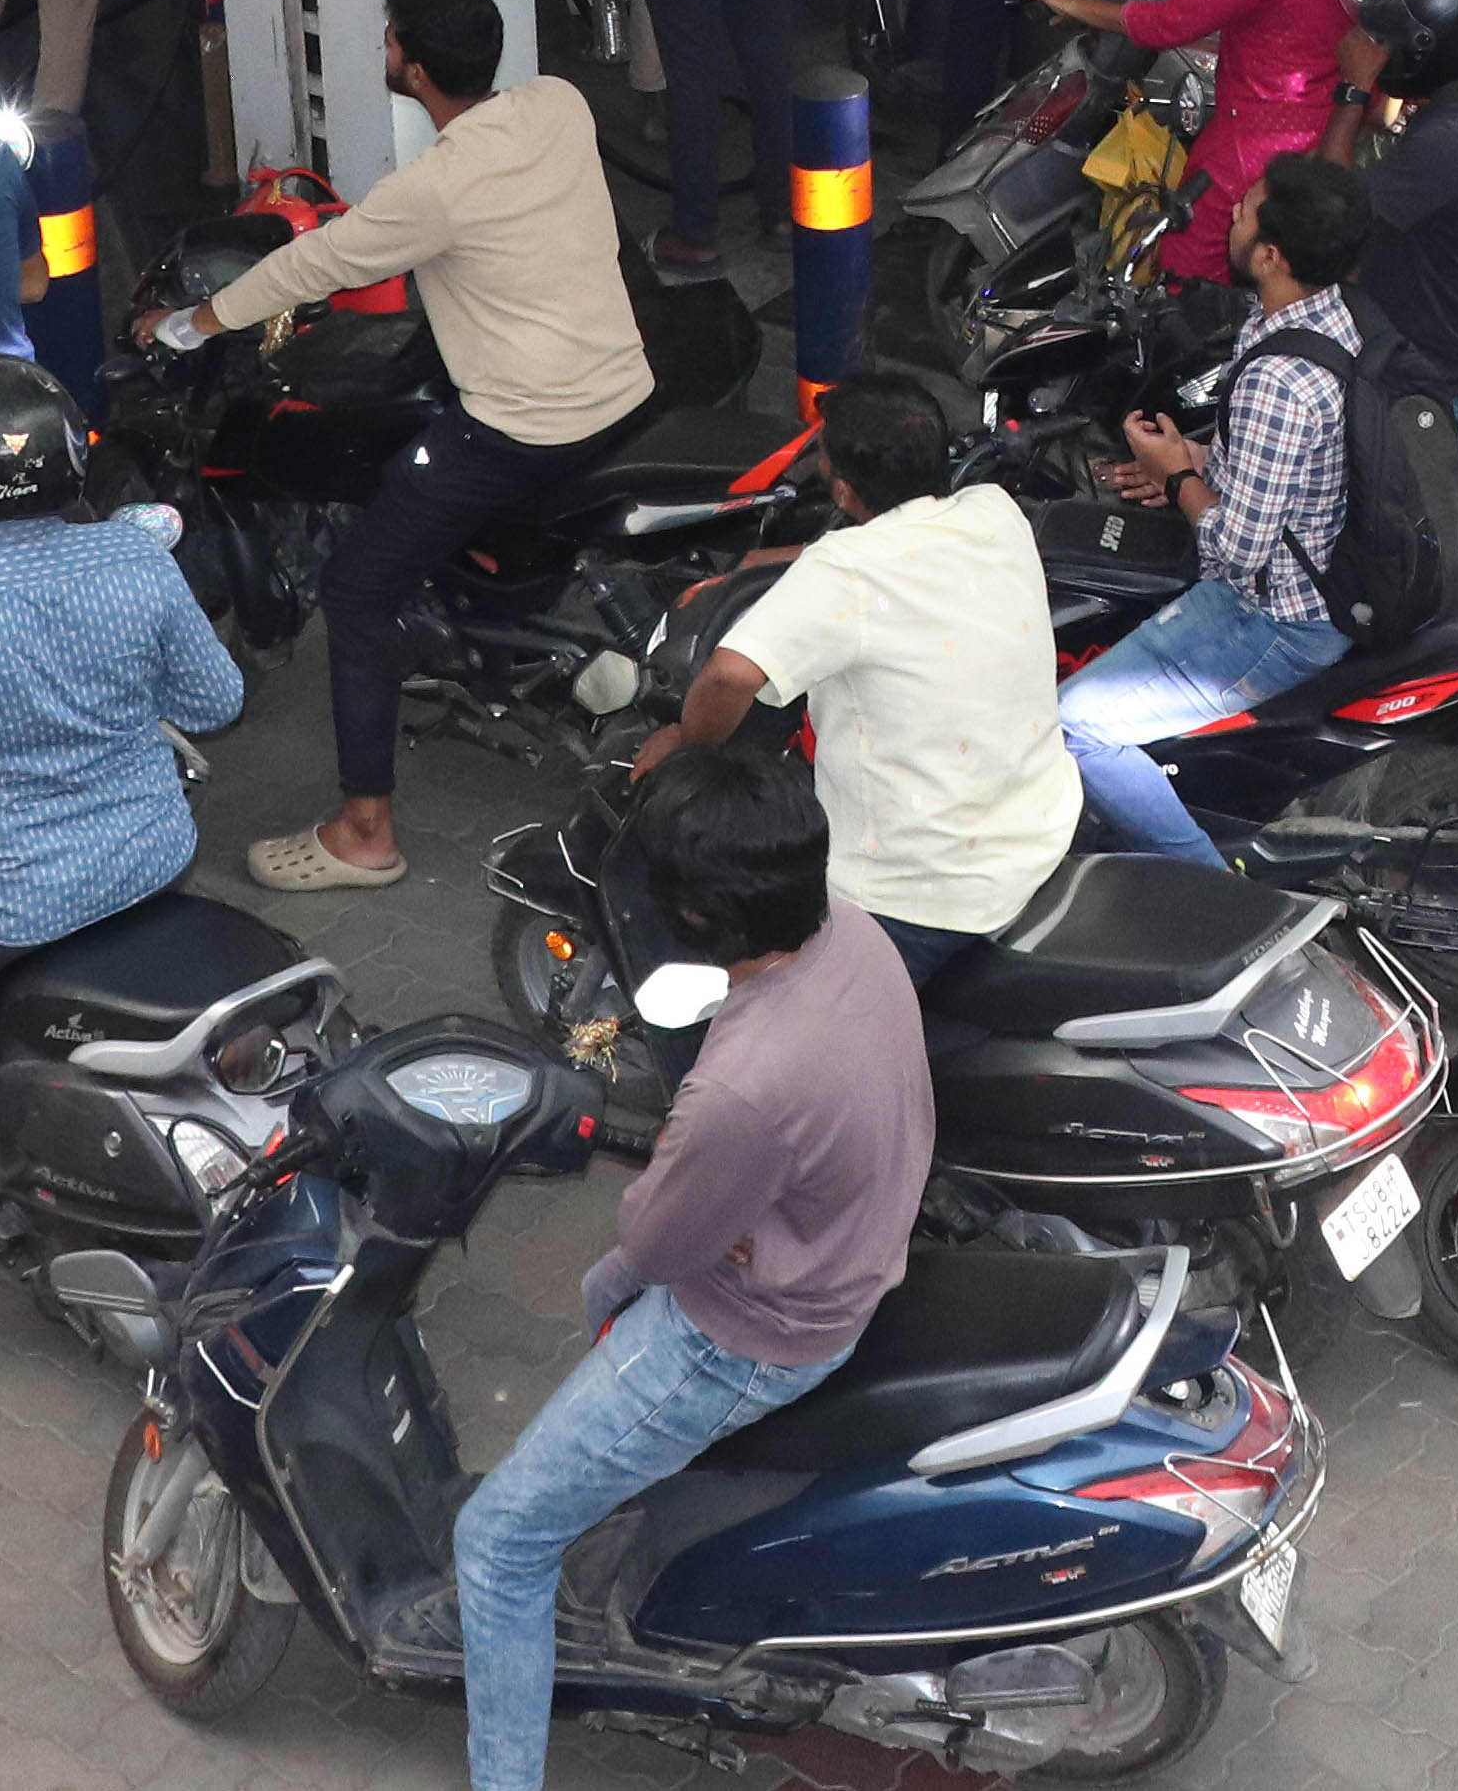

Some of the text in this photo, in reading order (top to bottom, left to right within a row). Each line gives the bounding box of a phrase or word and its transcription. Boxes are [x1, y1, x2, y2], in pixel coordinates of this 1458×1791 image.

[1099, 514, 1126, 552] SPEED
[1376, 696, 1416, 716] 200
[1343, 1171, 1401, 1231] TS08H
[1362, 1191, 1413, 1261] J8424
